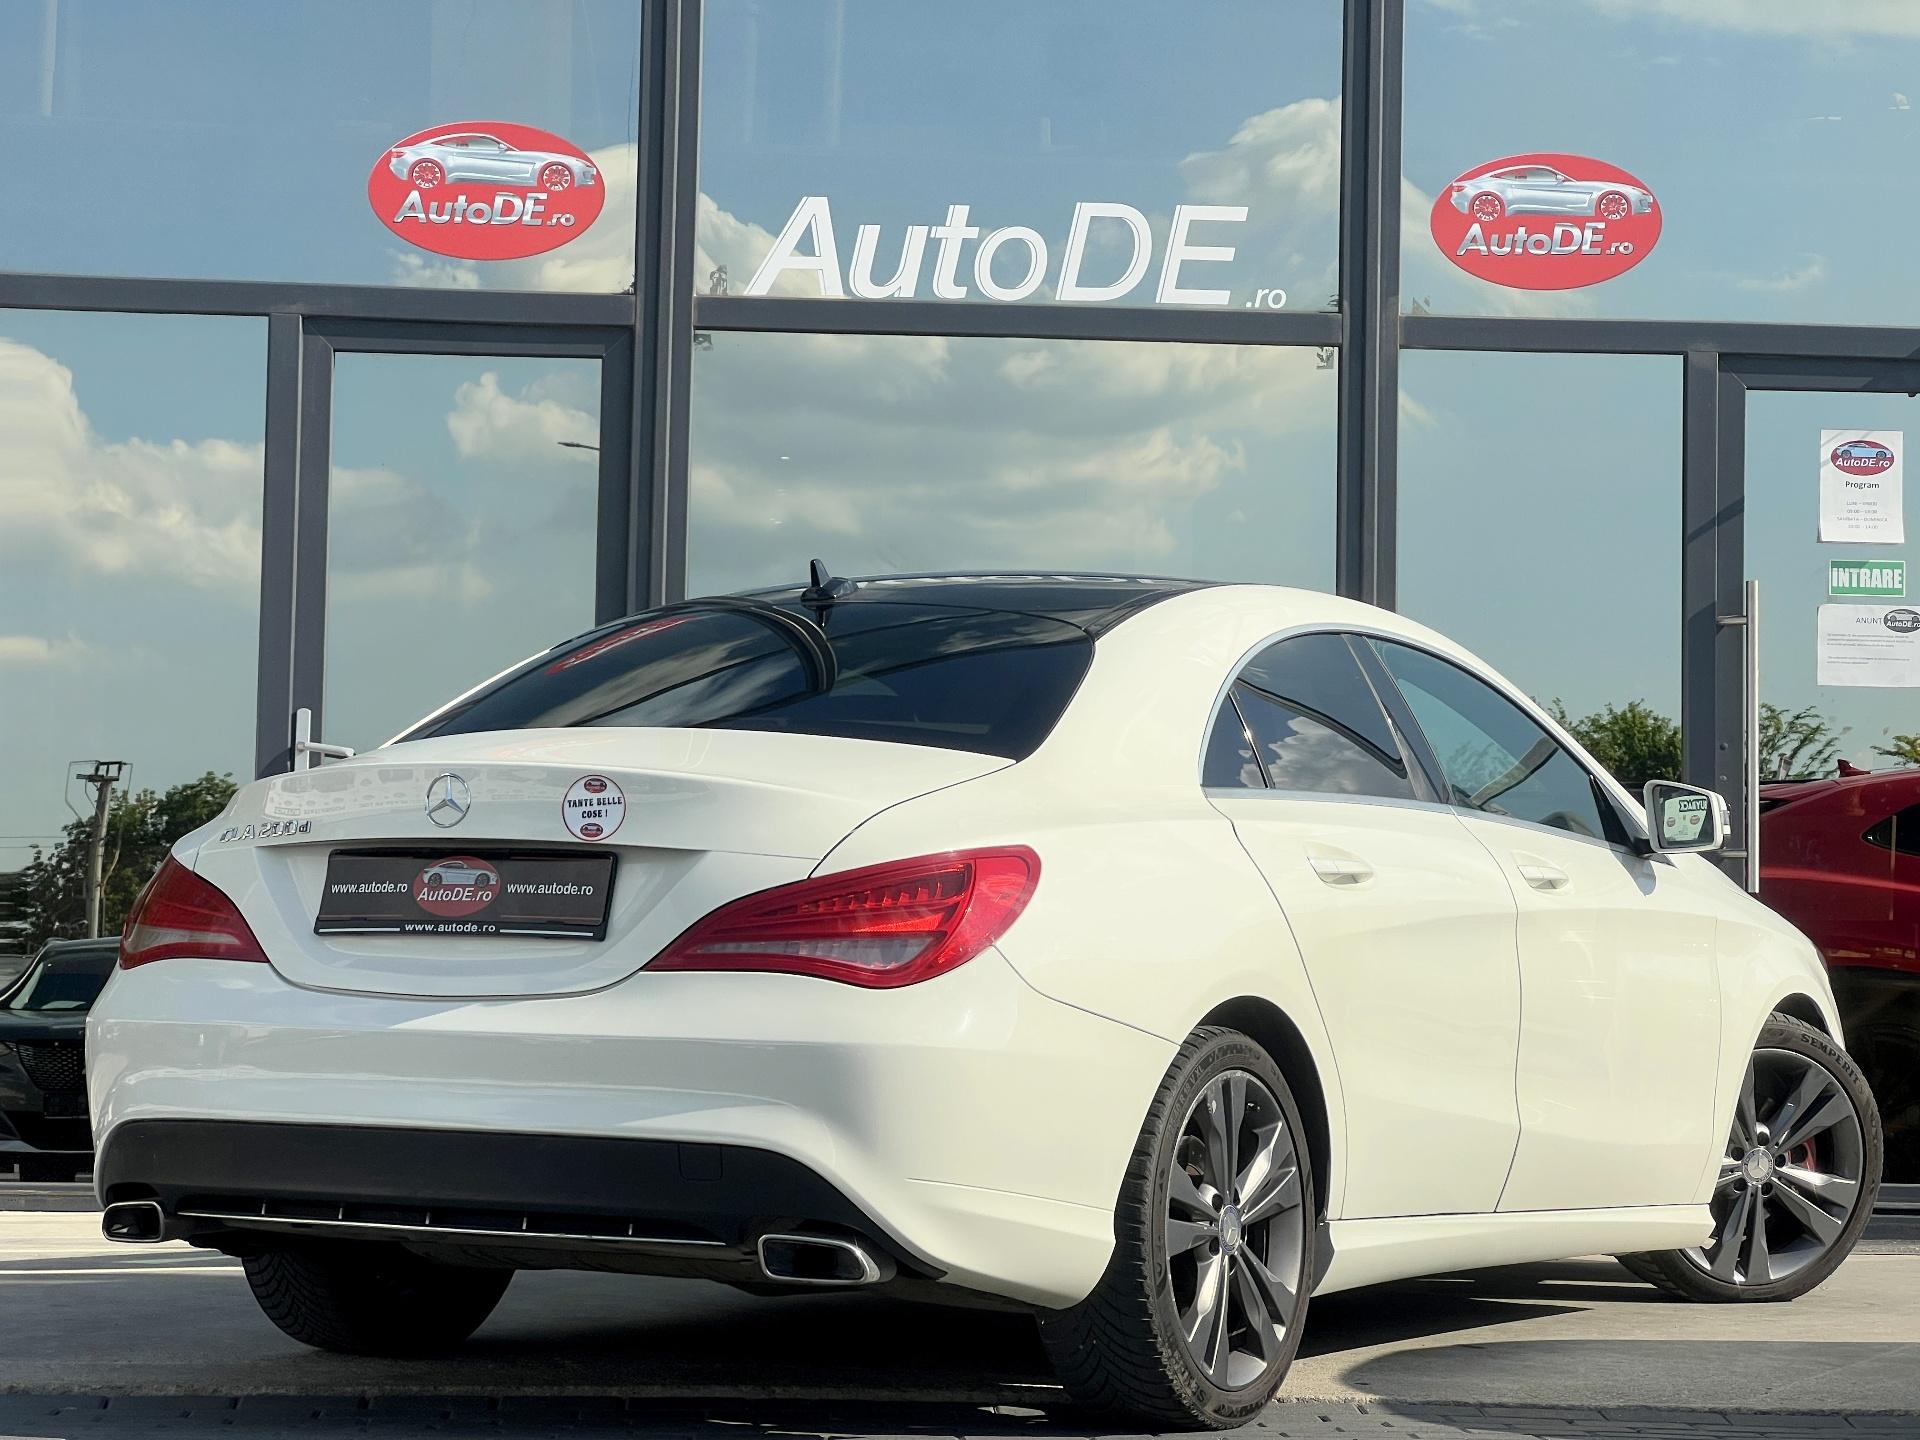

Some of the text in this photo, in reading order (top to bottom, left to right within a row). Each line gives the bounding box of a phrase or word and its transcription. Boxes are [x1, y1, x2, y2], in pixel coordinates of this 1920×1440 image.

[1835, 456, 1890, 468] AutoDE.ro
[1845, 480, 1880, 490] Program
[1832, 568, 1902, 588] INTRARE
[567, 797, 622, 808] TANTE BELLE
[582, 810, 602, 818] COSE
[331, 881, 408, 893] www.autode.ro
[507, 882, 593, 895] www.autode.ro
[417, 887, 492, 901] AutoDE.ro
[404, 922, 496, 933] www.autode.ro
[1800, 1032, 1861, 1084] SEMPERIT
